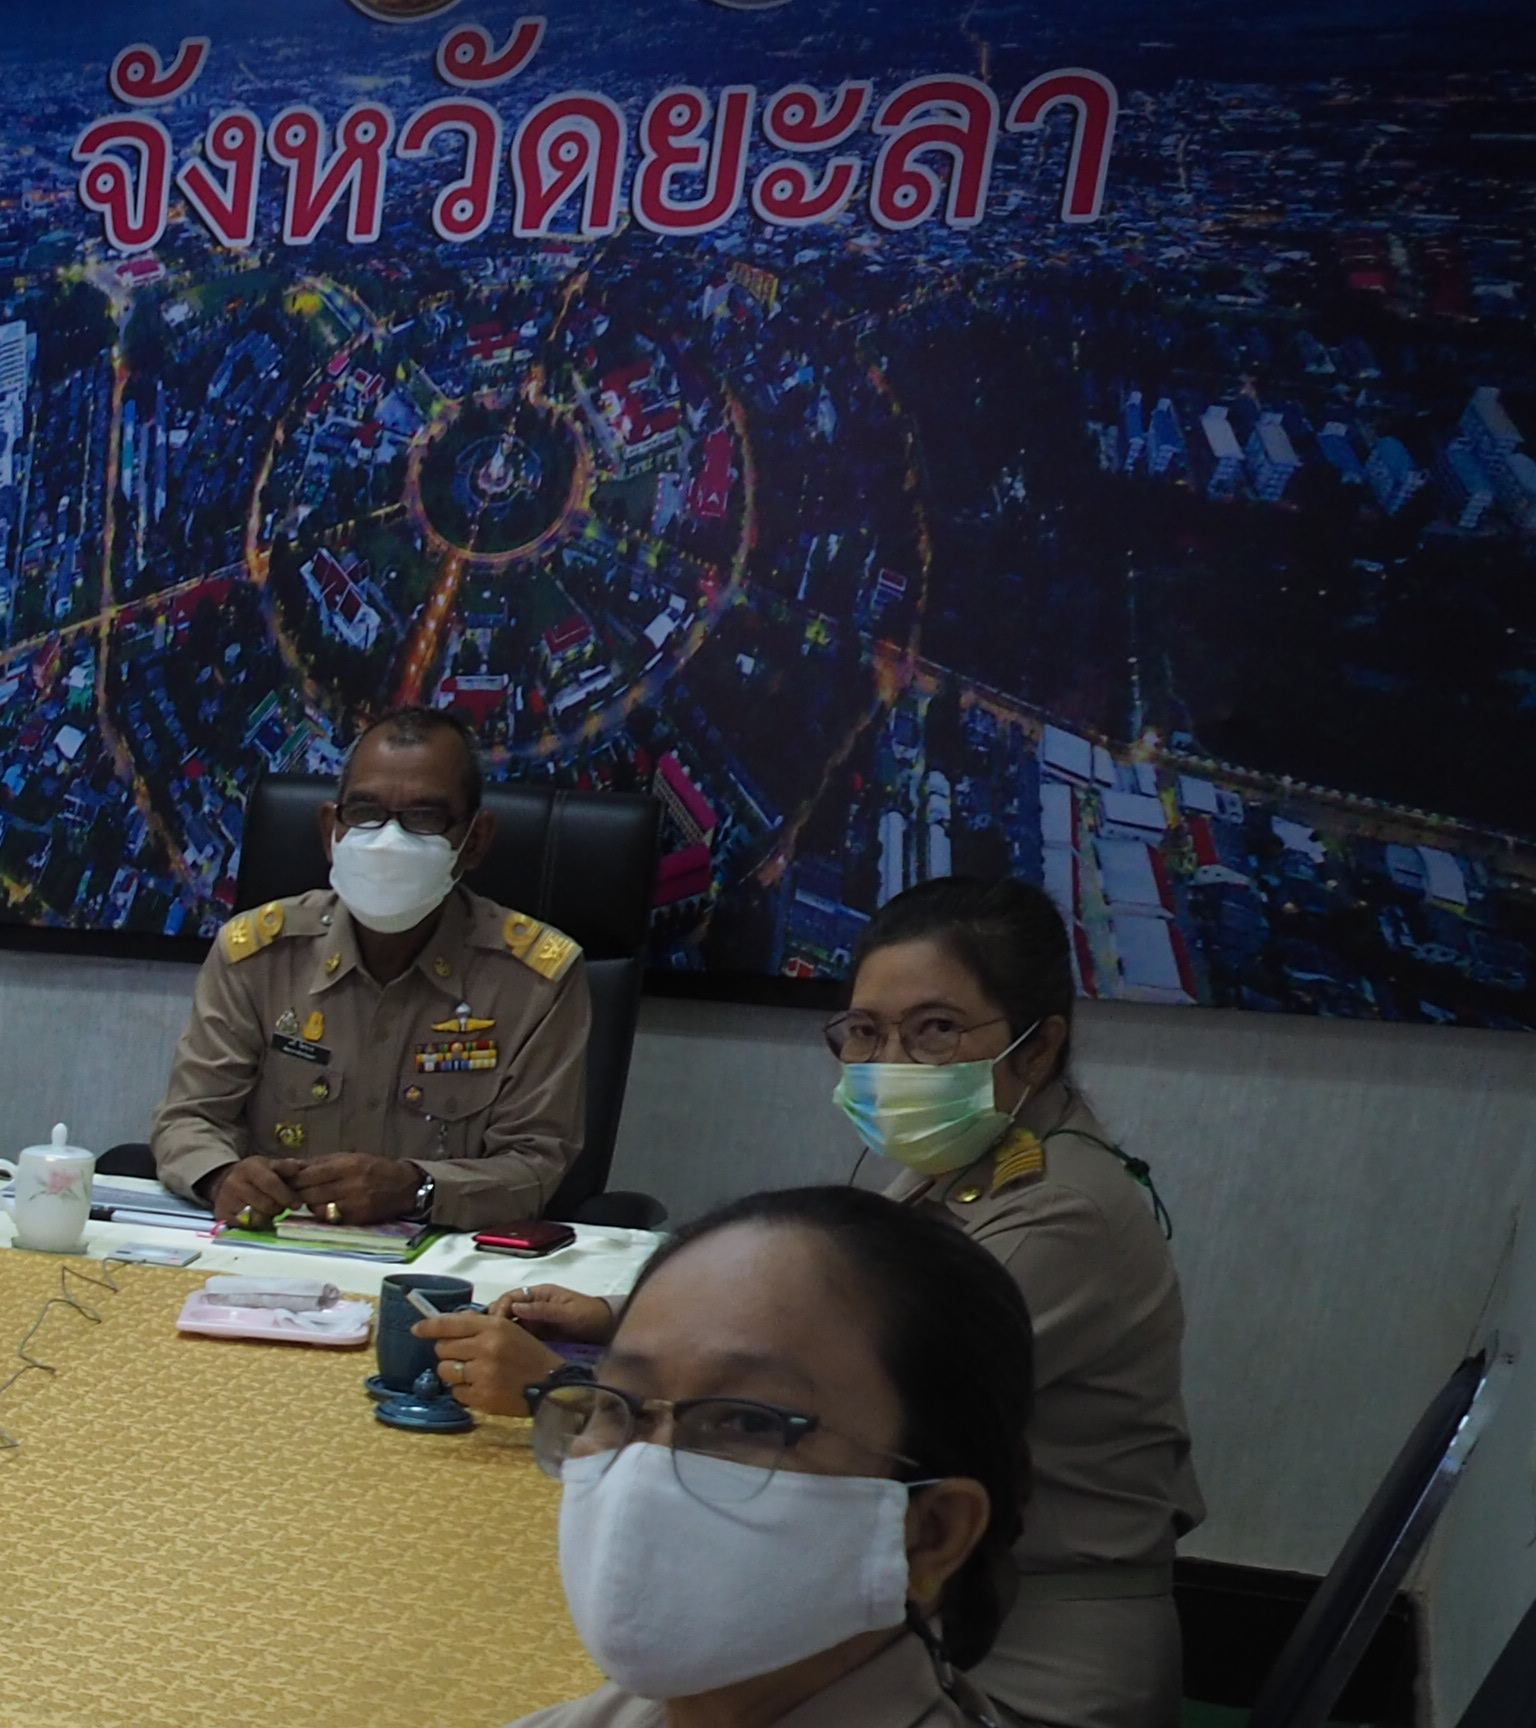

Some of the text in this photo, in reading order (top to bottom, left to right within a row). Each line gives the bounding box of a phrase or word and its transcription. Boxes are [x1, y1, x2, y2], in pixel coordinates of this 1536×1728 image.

[73, 17, 1117, 252] จังหวัดยะลา
